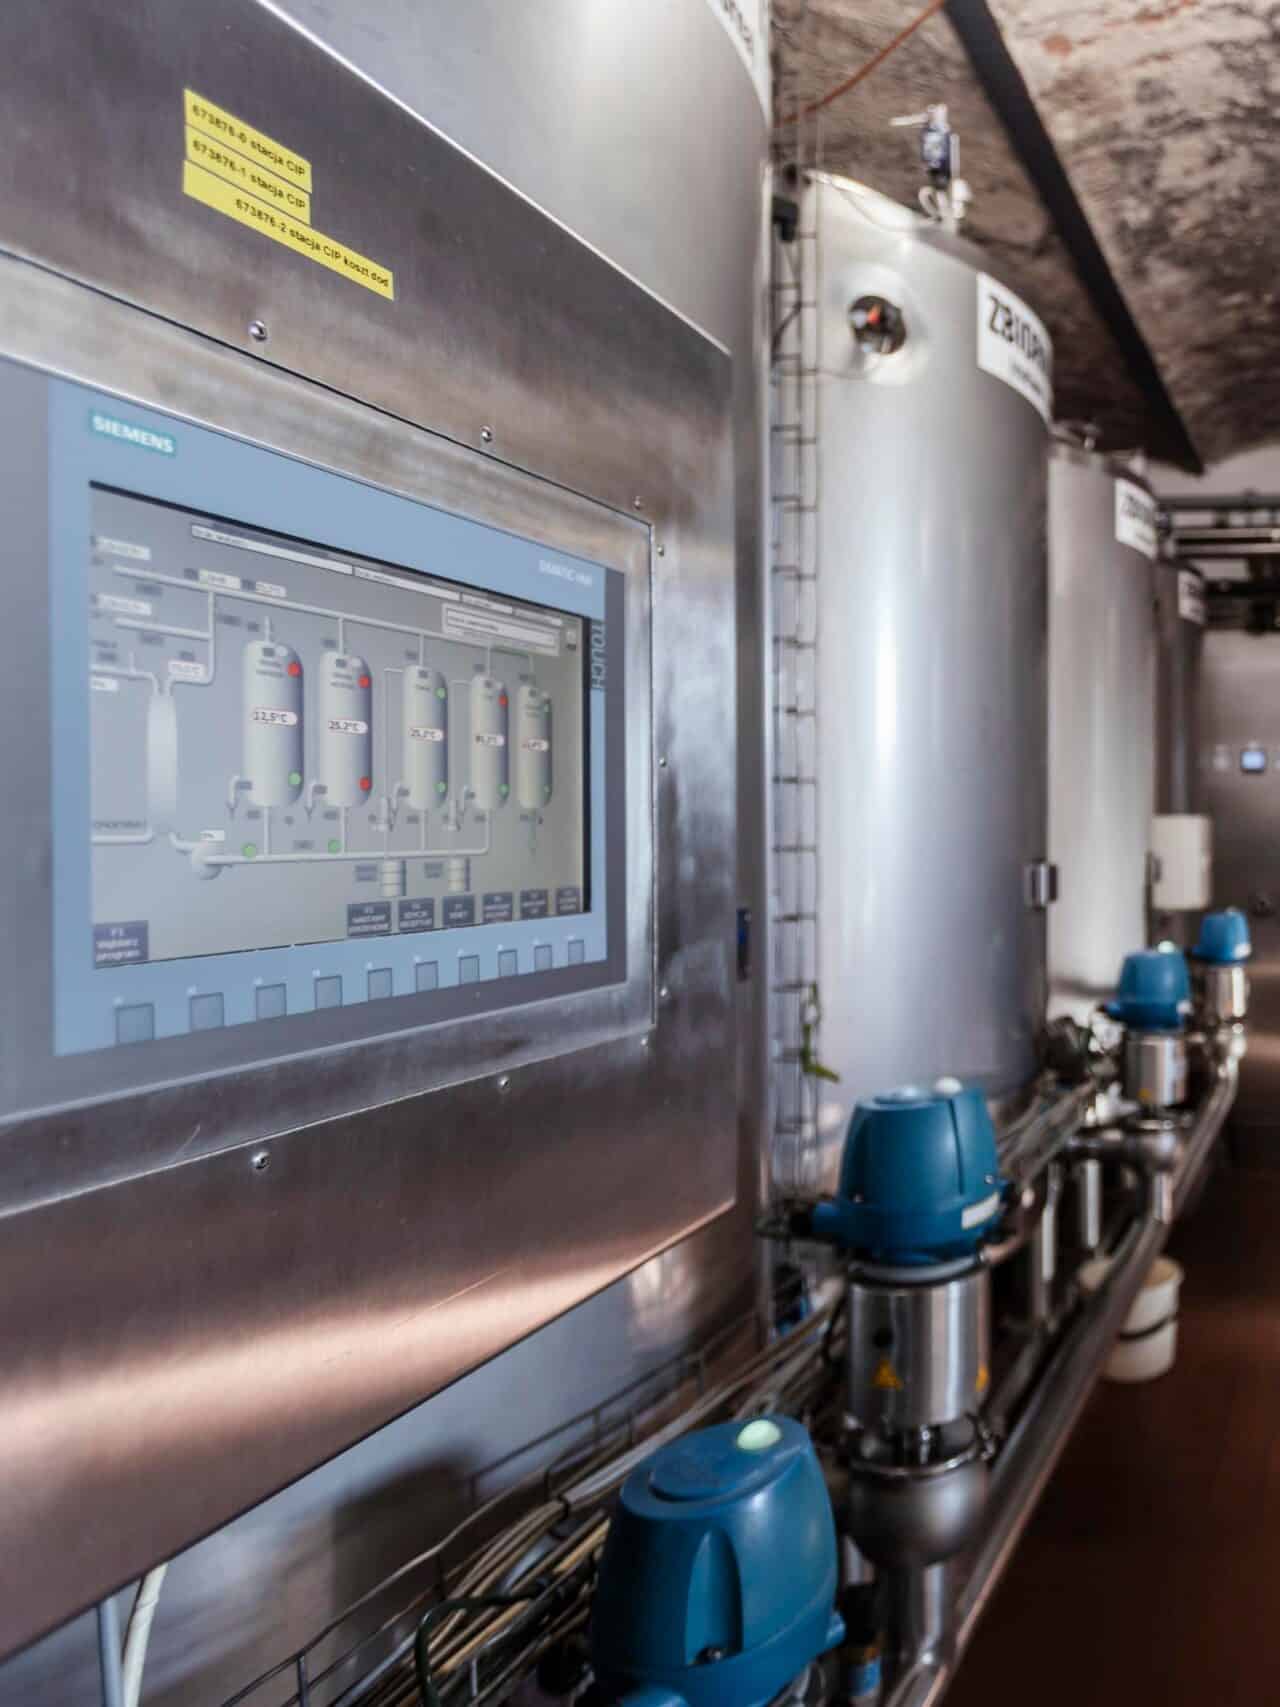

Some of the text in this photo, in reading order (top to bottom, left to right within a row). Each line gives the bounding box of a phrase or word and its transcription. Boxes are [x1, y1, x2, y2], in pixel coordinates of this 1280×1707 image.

[249, 138, 285, 168] stacja
[286, 158, 306, 177] CIP
[249, 171, 285, 201] stacja
[286, 191, 306, 210] CIP
[288, 227, 321, 252] stacja
[322, 243, 342, 261] CIP
[92, 415, 174, 453] SIEMENS
[588, 622, 606, 689] TOUCH
